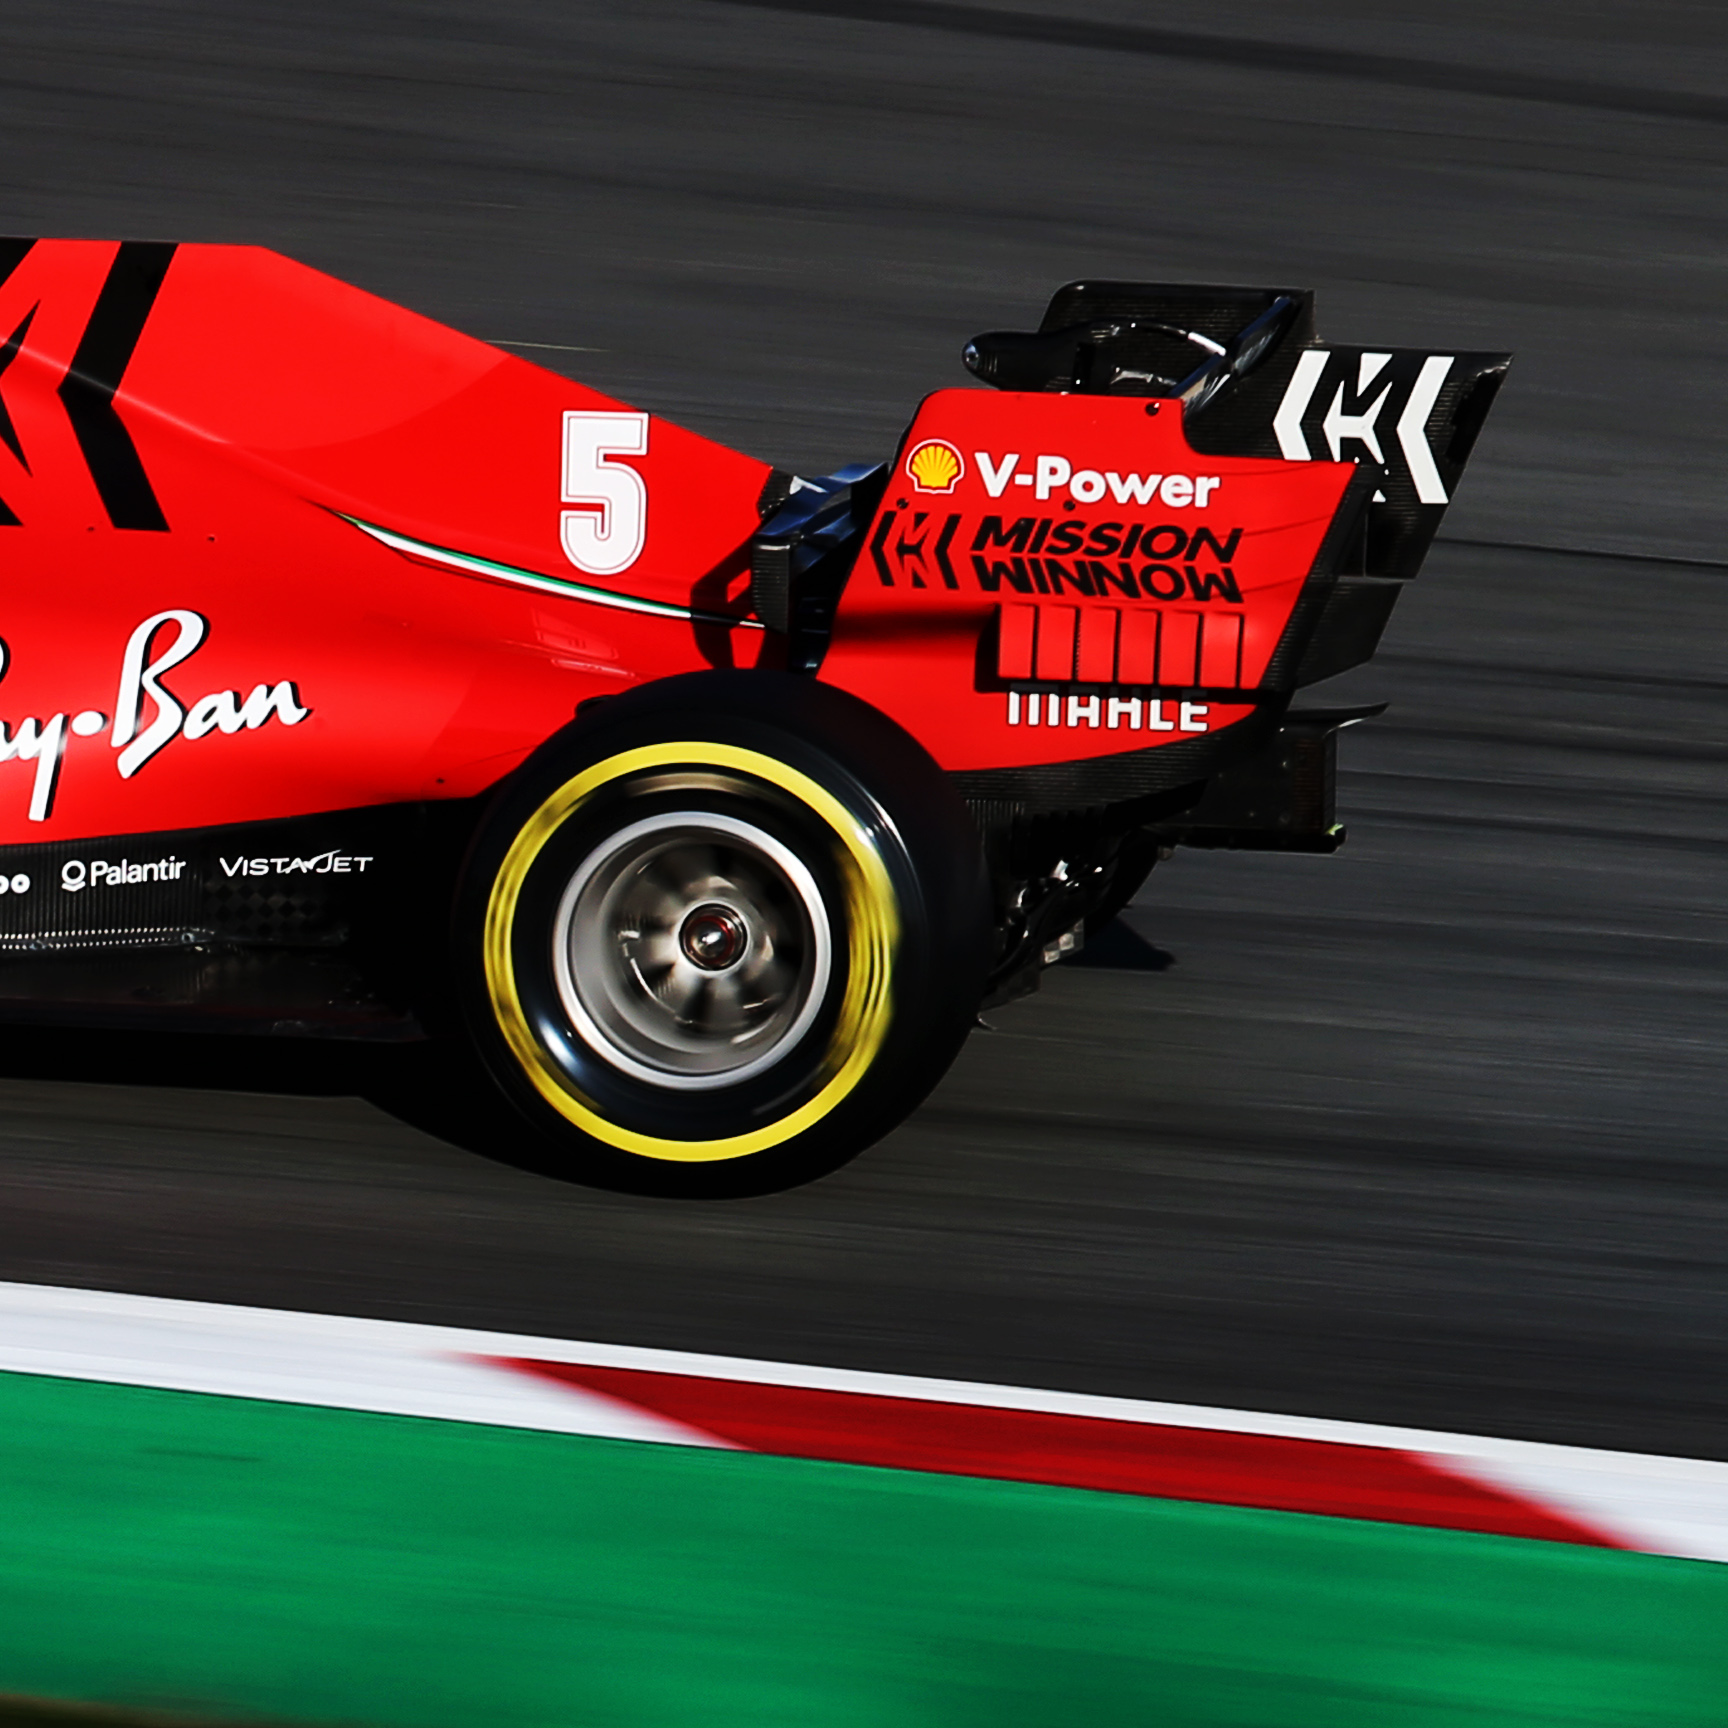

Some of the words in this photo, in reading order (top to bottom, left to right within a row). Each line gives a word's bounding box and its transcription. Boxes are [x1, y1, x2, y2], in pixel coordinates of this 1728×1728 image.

[559, 410, 650, 575] 5
[973, 452, 1221, 508] V-Power
[971, 515, 1244, 563] MISSION
[971, 554, 1245, 603] WINNOW
[1007, 683, 1209, 732] MAHLE
[91, 855, 187, 887] Palantir
